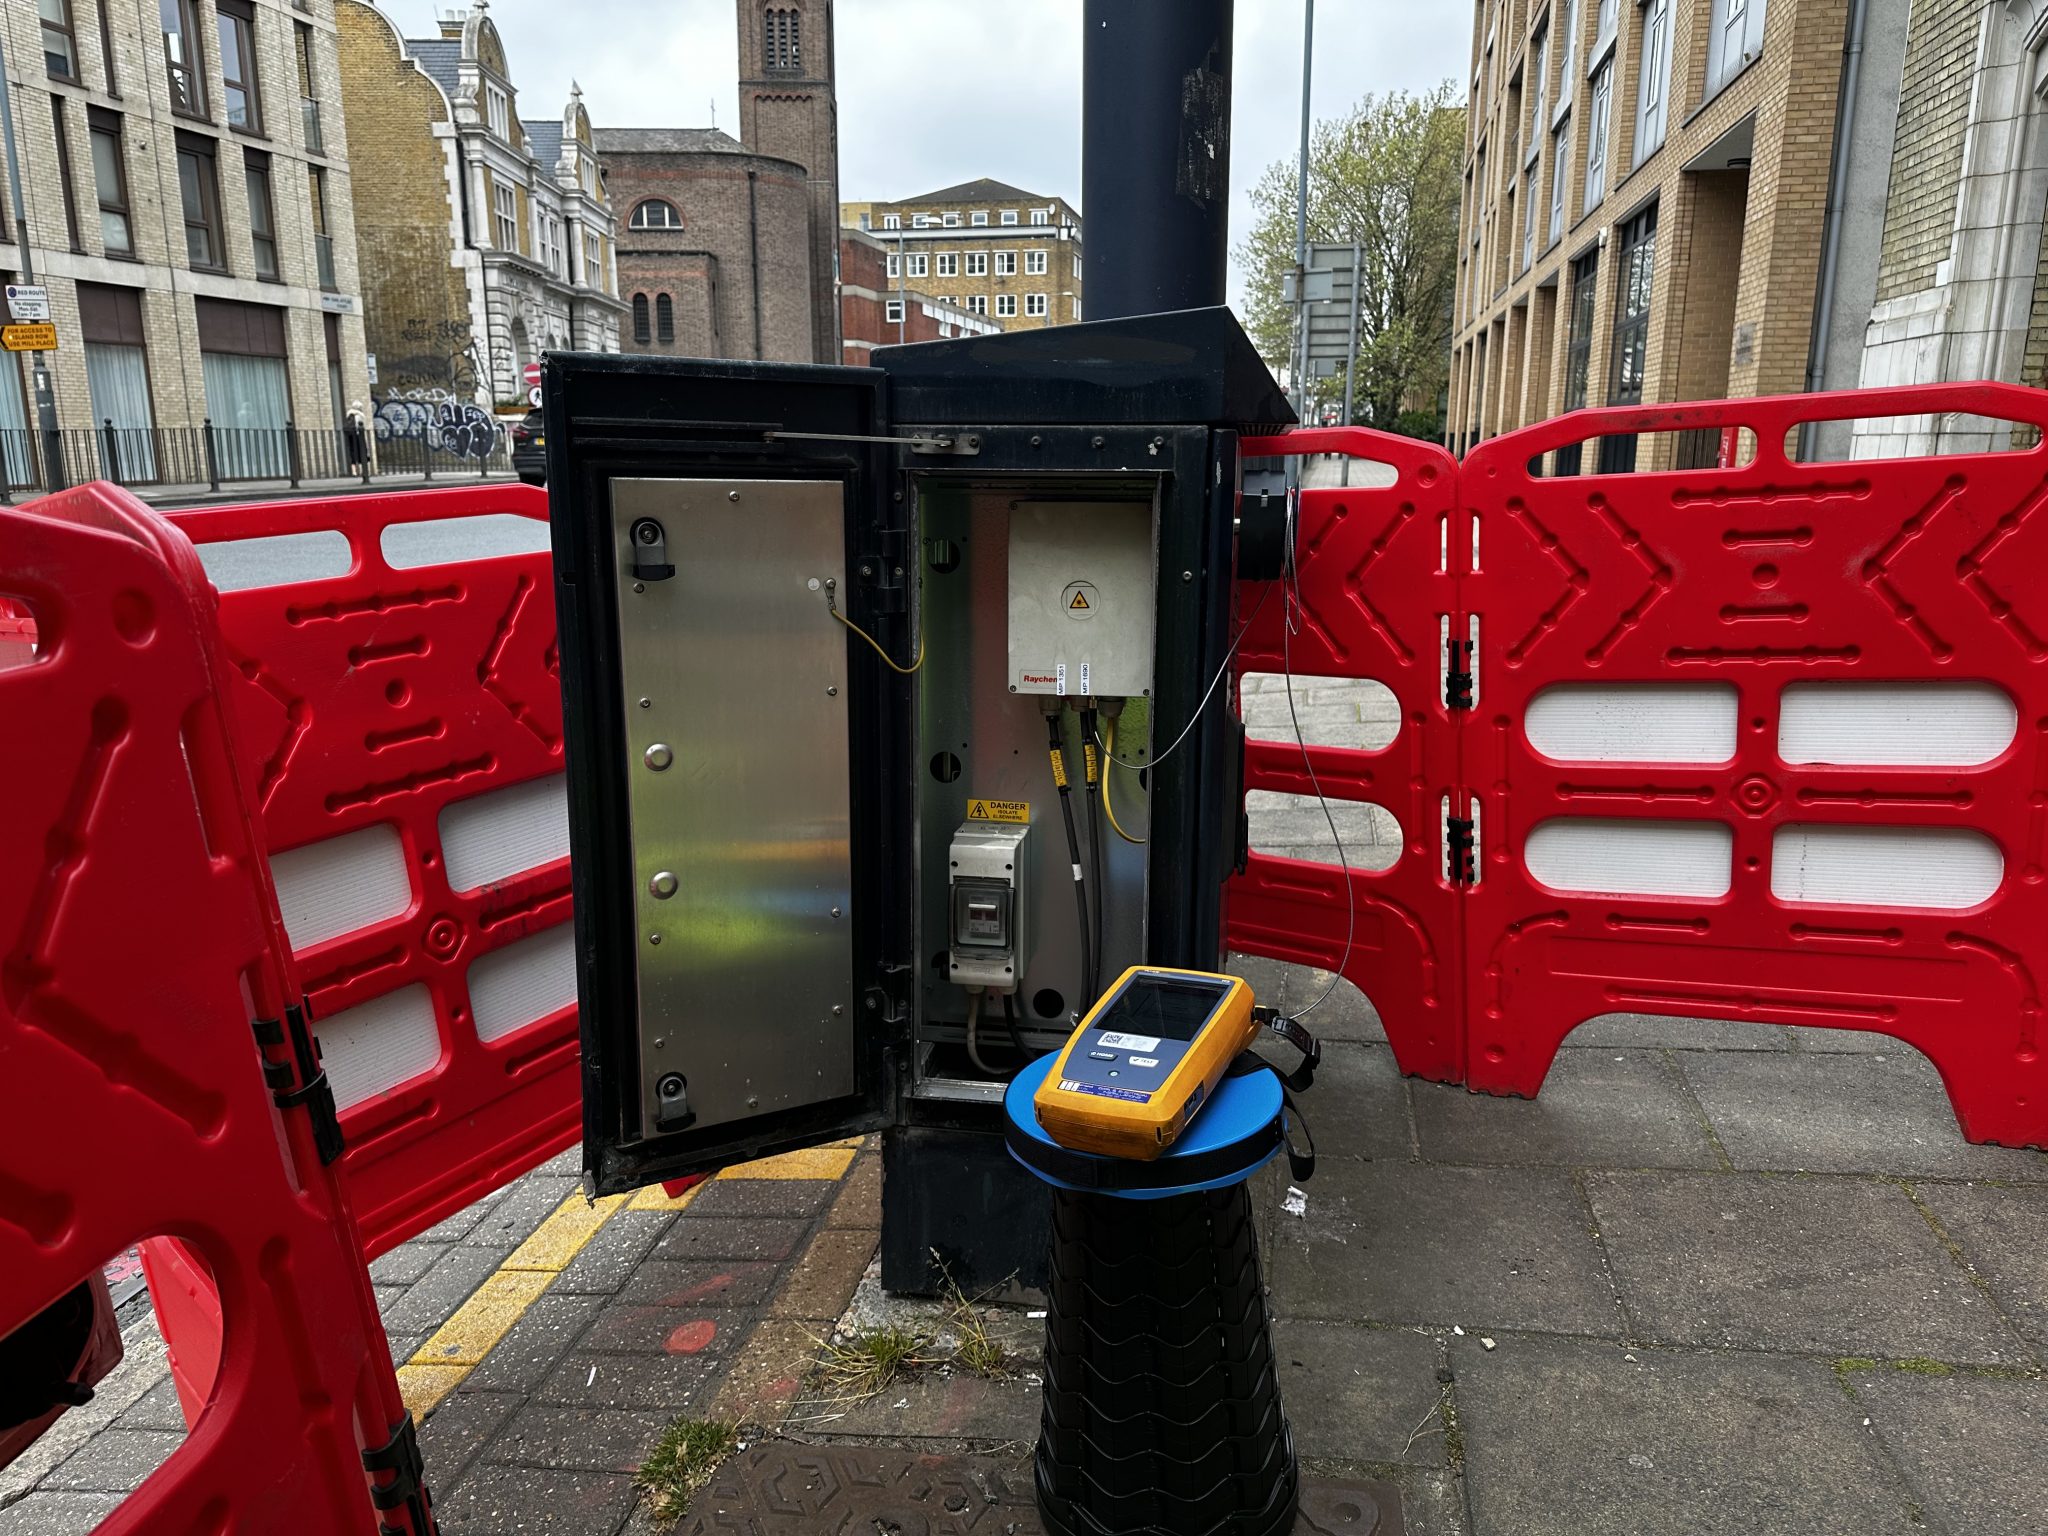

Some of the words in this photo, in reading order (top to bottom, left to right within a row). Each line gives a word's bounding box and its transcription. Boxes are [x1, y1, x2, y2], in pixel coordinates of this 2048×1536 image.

[1058, 683, 1064, 694] MP
[1082, 684, 1088, 694] MP
[990, 802, 1026, 811] DANGER
